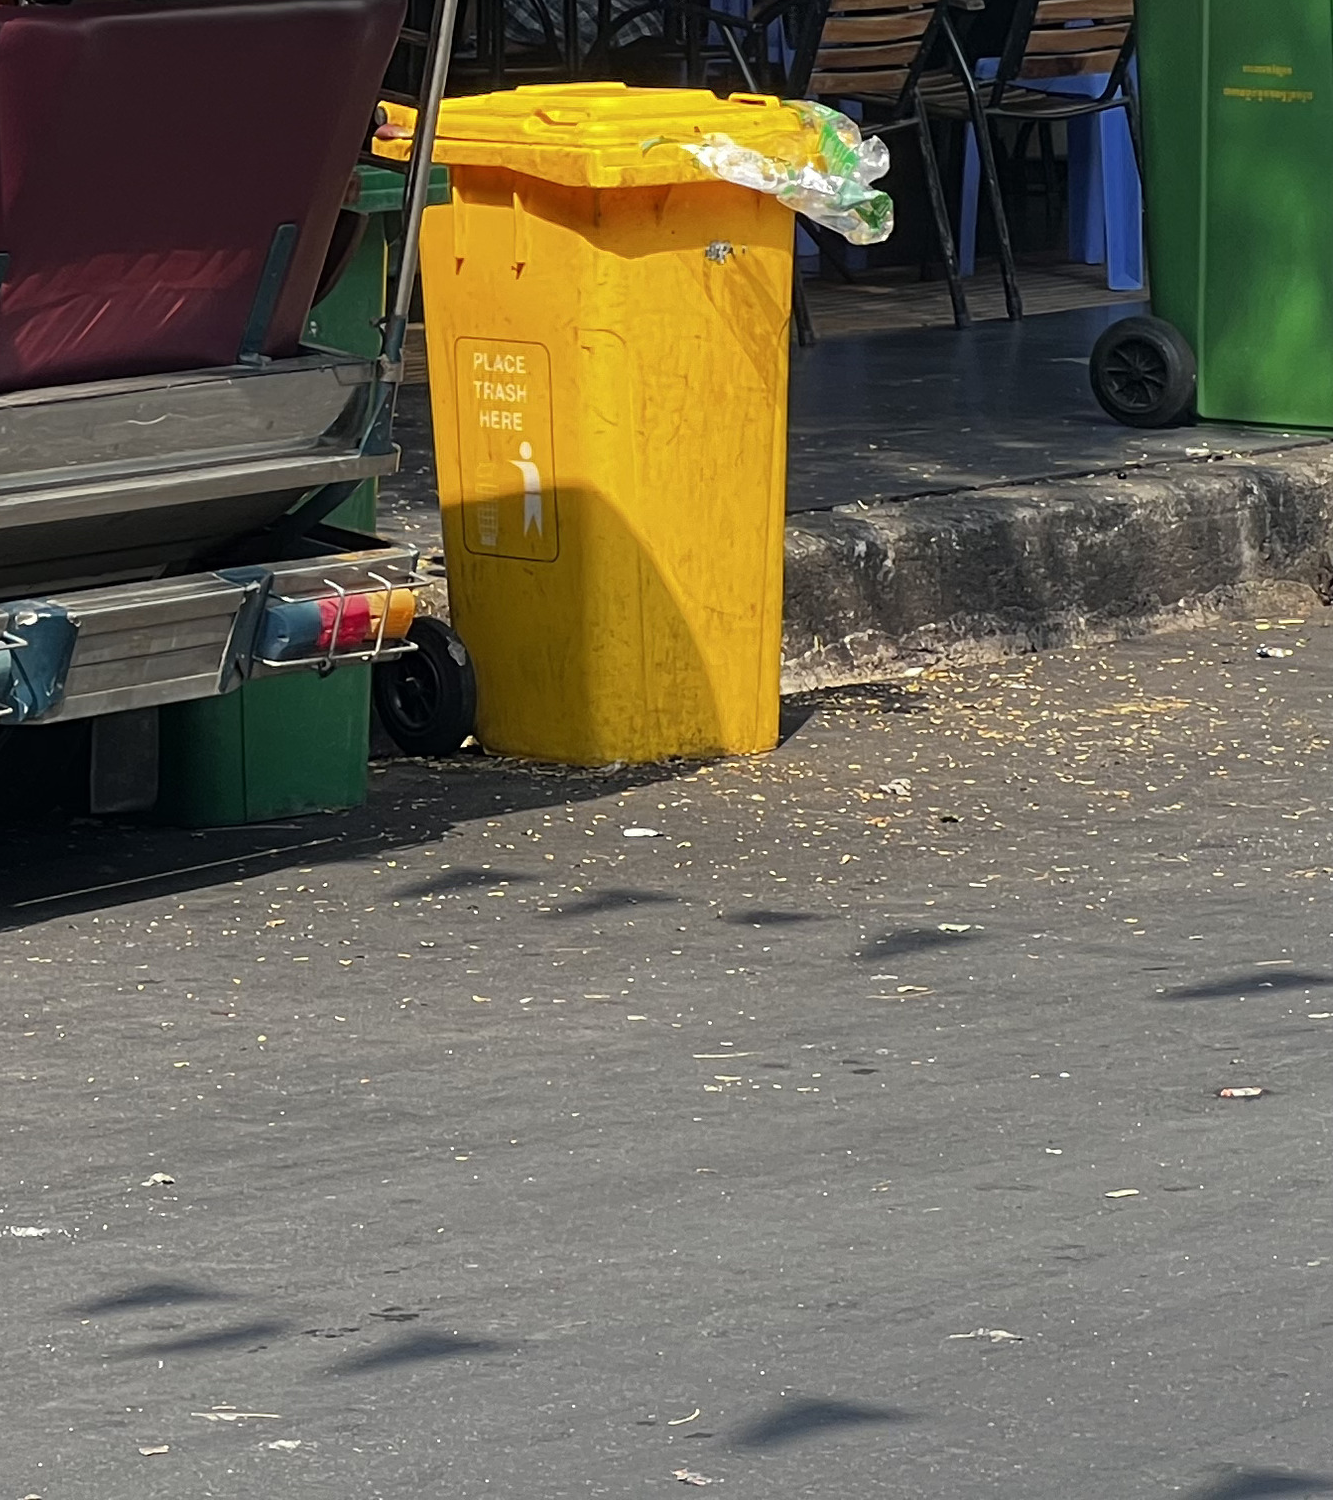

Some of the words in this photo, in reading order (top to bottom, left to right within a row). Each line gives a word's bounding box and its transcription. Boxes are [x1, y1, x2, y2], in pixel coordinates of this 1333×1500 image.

[473, 352, 526, 374] PLACE
[473, 380, 528, 404] TRASH
[479, 409, 523, 431] HERE
